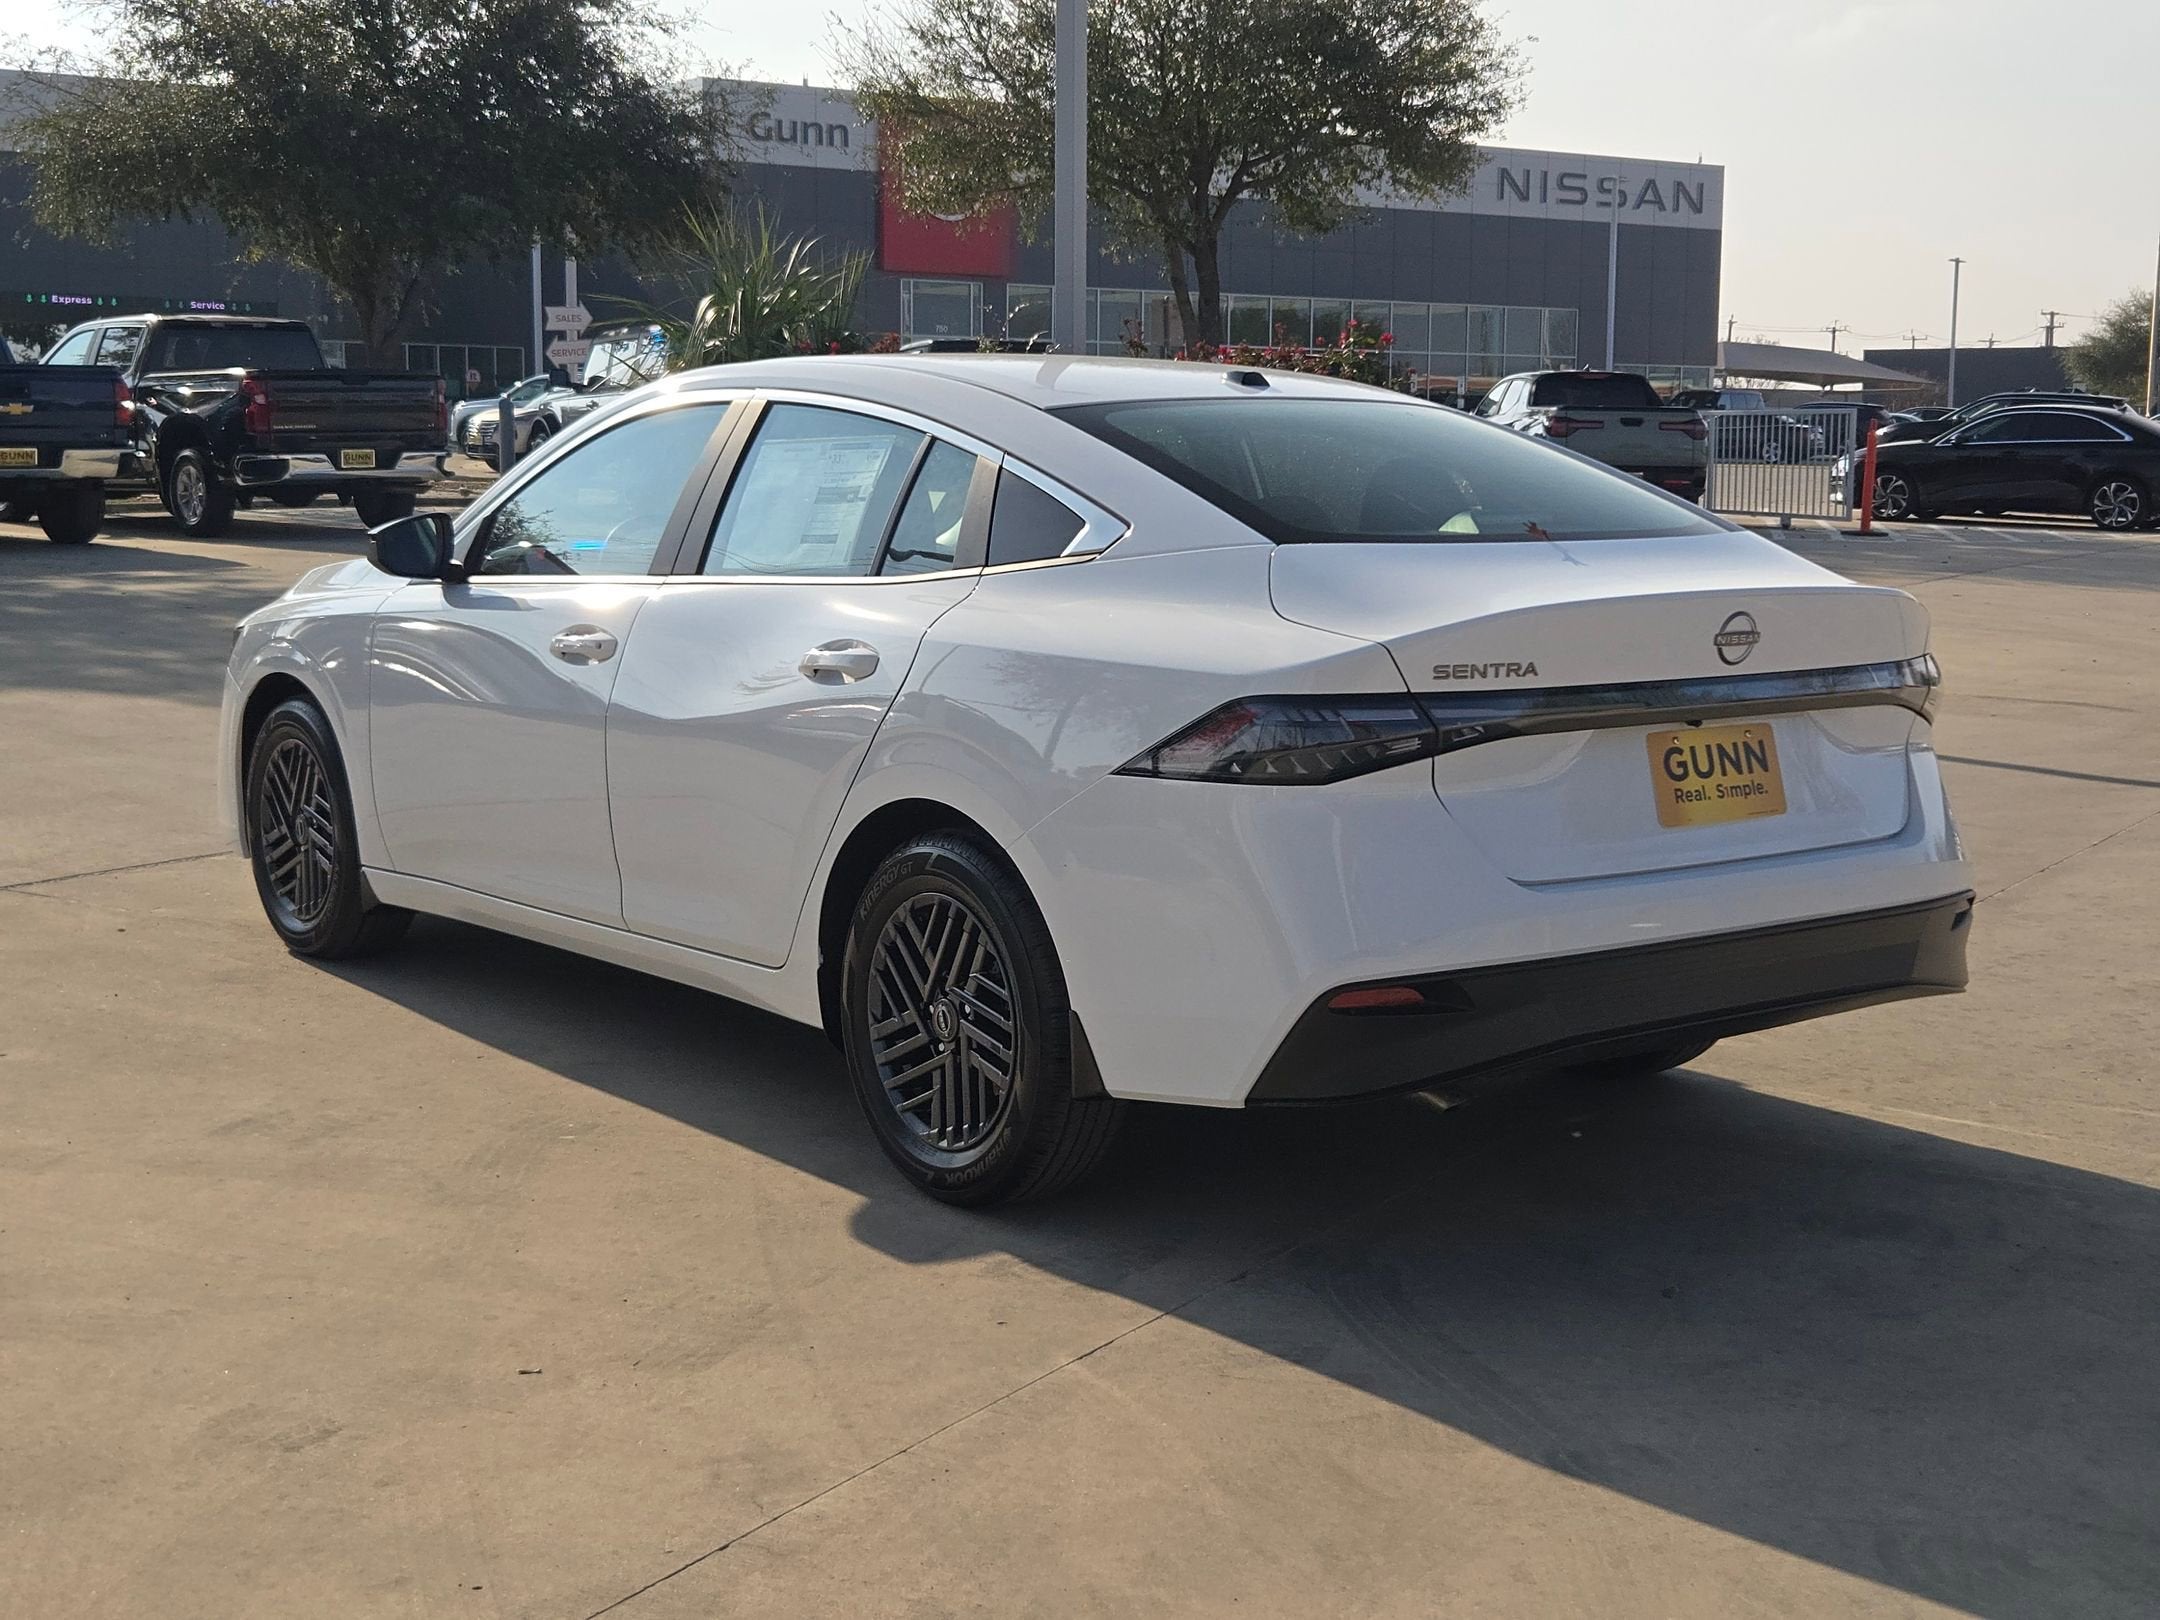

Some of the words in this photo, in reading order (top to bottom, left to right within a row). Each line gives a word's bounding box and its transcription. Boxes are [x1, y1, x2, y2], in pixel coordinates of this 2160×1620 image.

[751, 112, 849, 147] Gunn
[1497, 167, 1704, 214] NISSAN
[51, 294, 92, 305] Express
[190, 301, 225, 310] Service
[555, 314, 582, 323] SALES
[551, 347, 587, 357] SERVICE
[1, 450, 33, 460] GUNN
[344, 453, 371, 461] GUNN
[1717, 632, 1761, 646] NISSAN
[1433, 662, 1539, 680] SENTRA
[1663, 739, 1769, 782] GUNN
[1674, 785, 1712, 804] Real.
